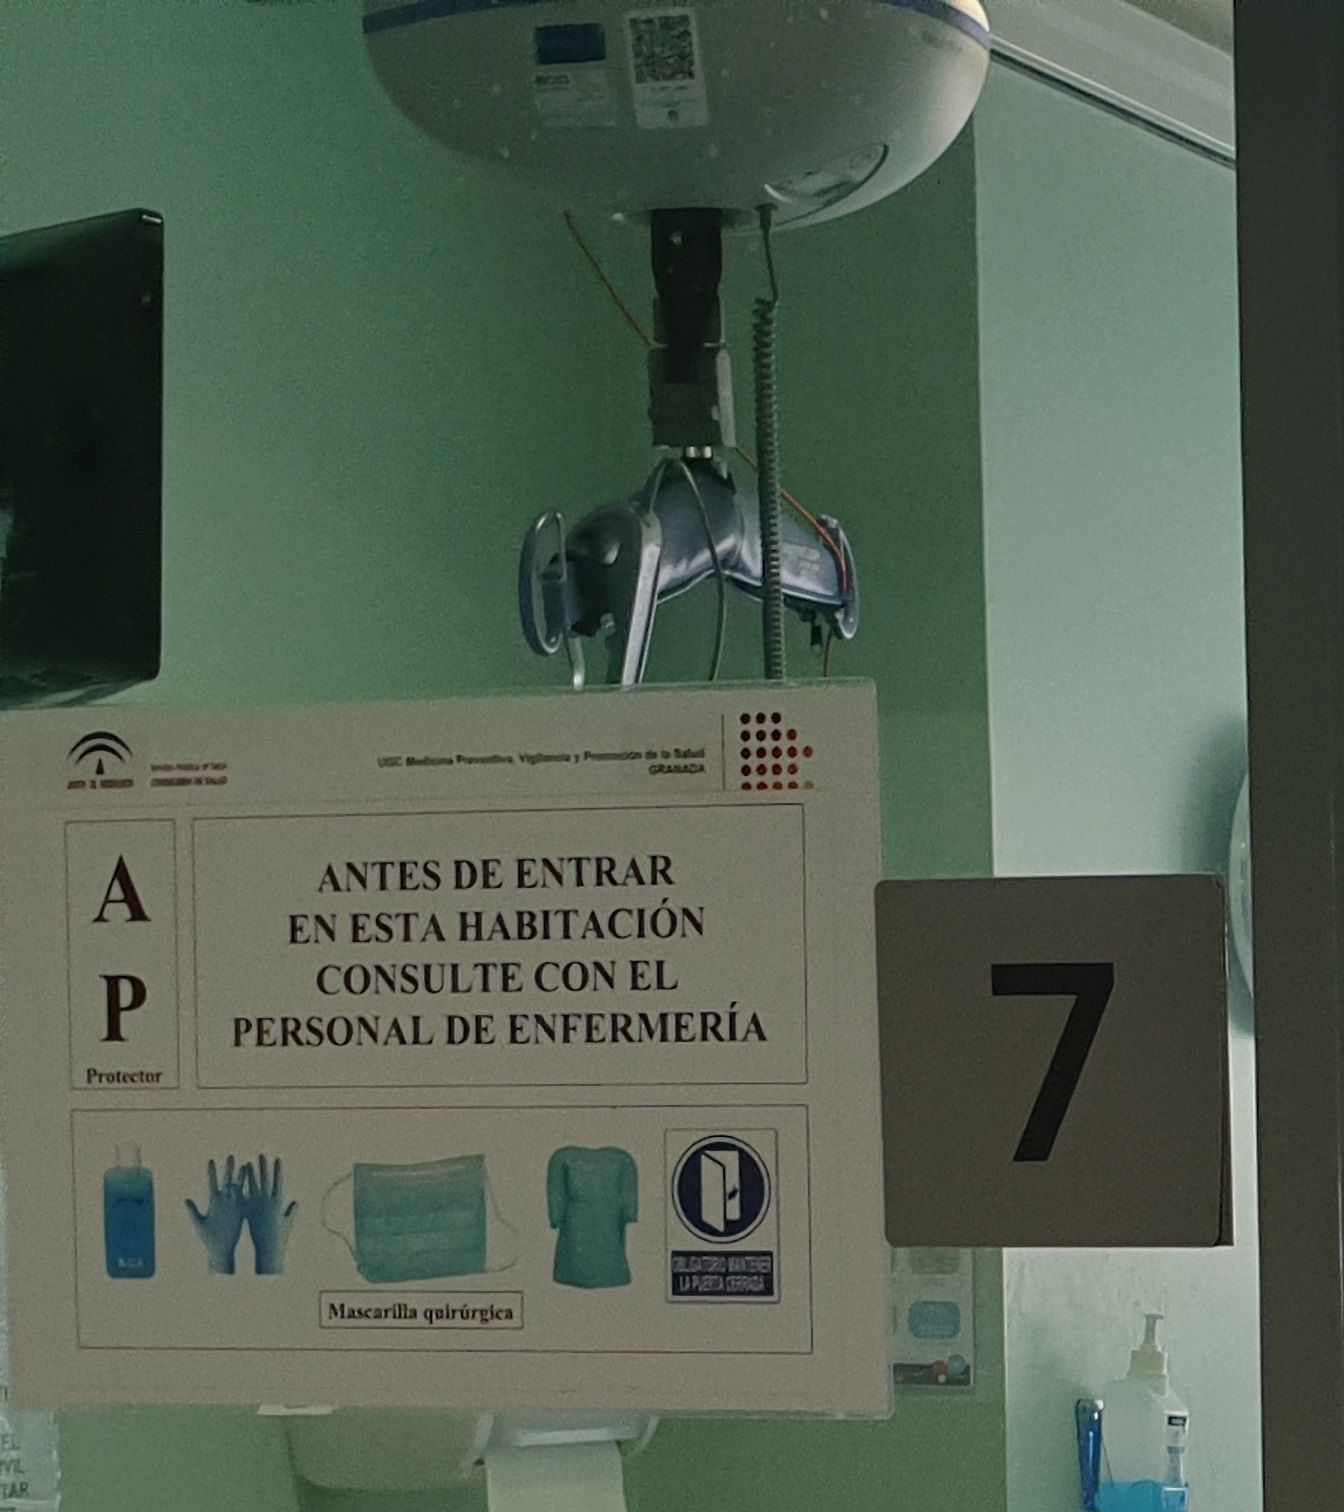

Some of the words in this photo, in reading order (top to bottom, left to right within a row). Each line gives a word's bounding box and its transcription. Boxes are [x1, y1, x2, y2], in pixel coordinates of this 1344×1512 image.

[92, 854, 151, 922] A
[318, 859, 441, 894] ANTES
[453, 858, 503, 890] DE
[516, 855, 675, 889] ENTRAR
[289, 913, 337, 945] EN
[351, 911, 446, 944] ESTA
[458, 898, 705, 942] HABITACIÓN
[316, 962, 523, 996] CONSULTE
[534, 960, 617, 994] CON
[628, 959, 679, 992] EL
[99, 974, 147, 1042] P
[232, 1014, 434, 1048] PERSONAL
[446, 1013, 496, 1047] DE
[509, 1002, 768, 1046] ENFERMERÍA
[86, 1067, 163, 1085] Protector
[991, 963, 1114, 1162] 7
[328, 1302, 418, 1320] Mascarilla
[423, 1303, 514, 1325] quirúrgica
